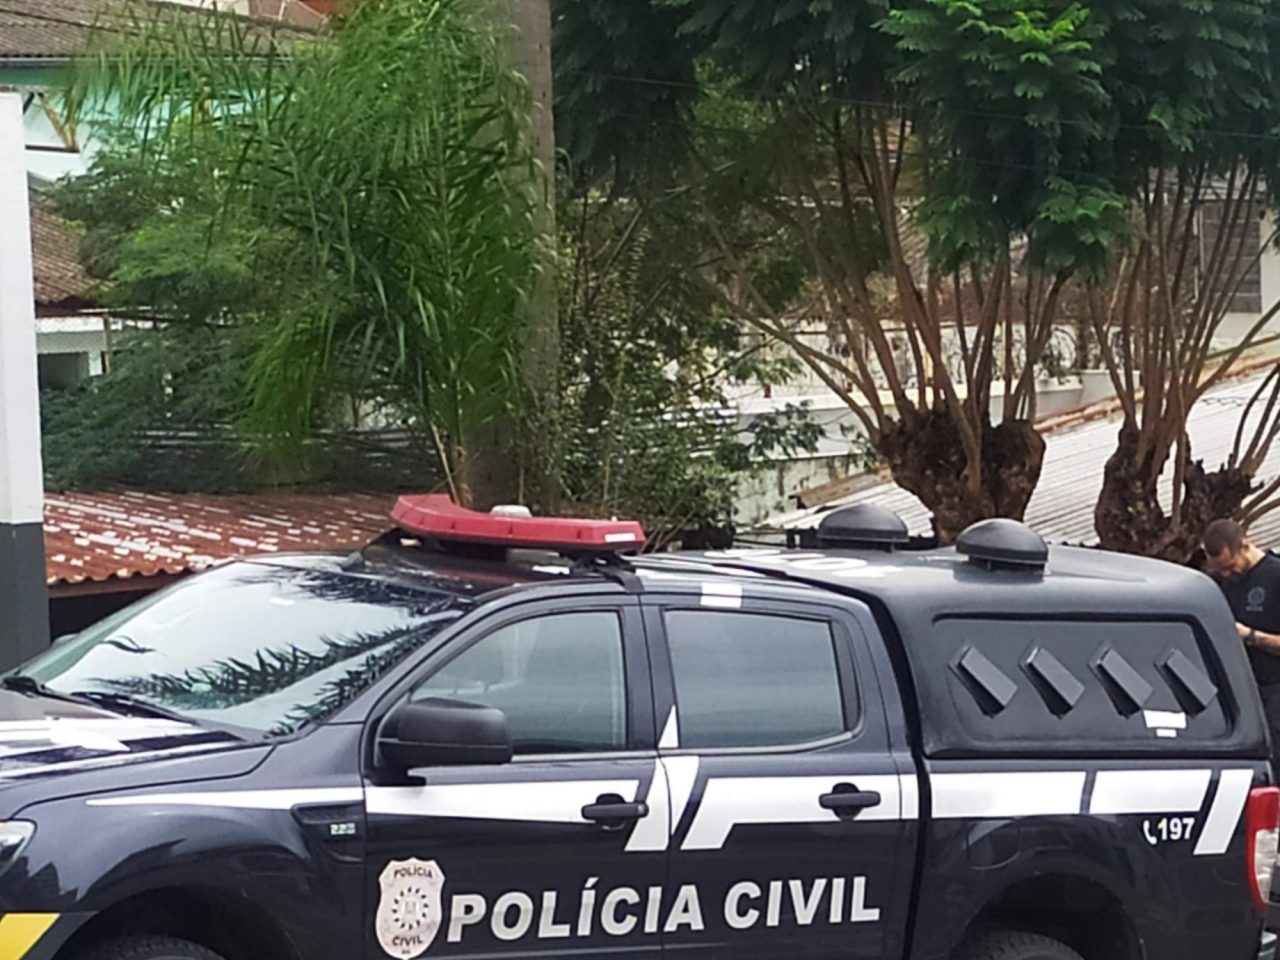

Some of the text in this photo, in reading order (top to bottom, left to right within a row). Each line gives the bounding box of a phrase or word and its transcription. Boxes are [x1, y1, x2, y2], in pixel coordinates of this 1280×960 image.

[1157, 817, 1195, 840] 197
[446, 876, 880, 943] POLÍCIA CIVIL
[391, 935, 423, 947] CIVIL
